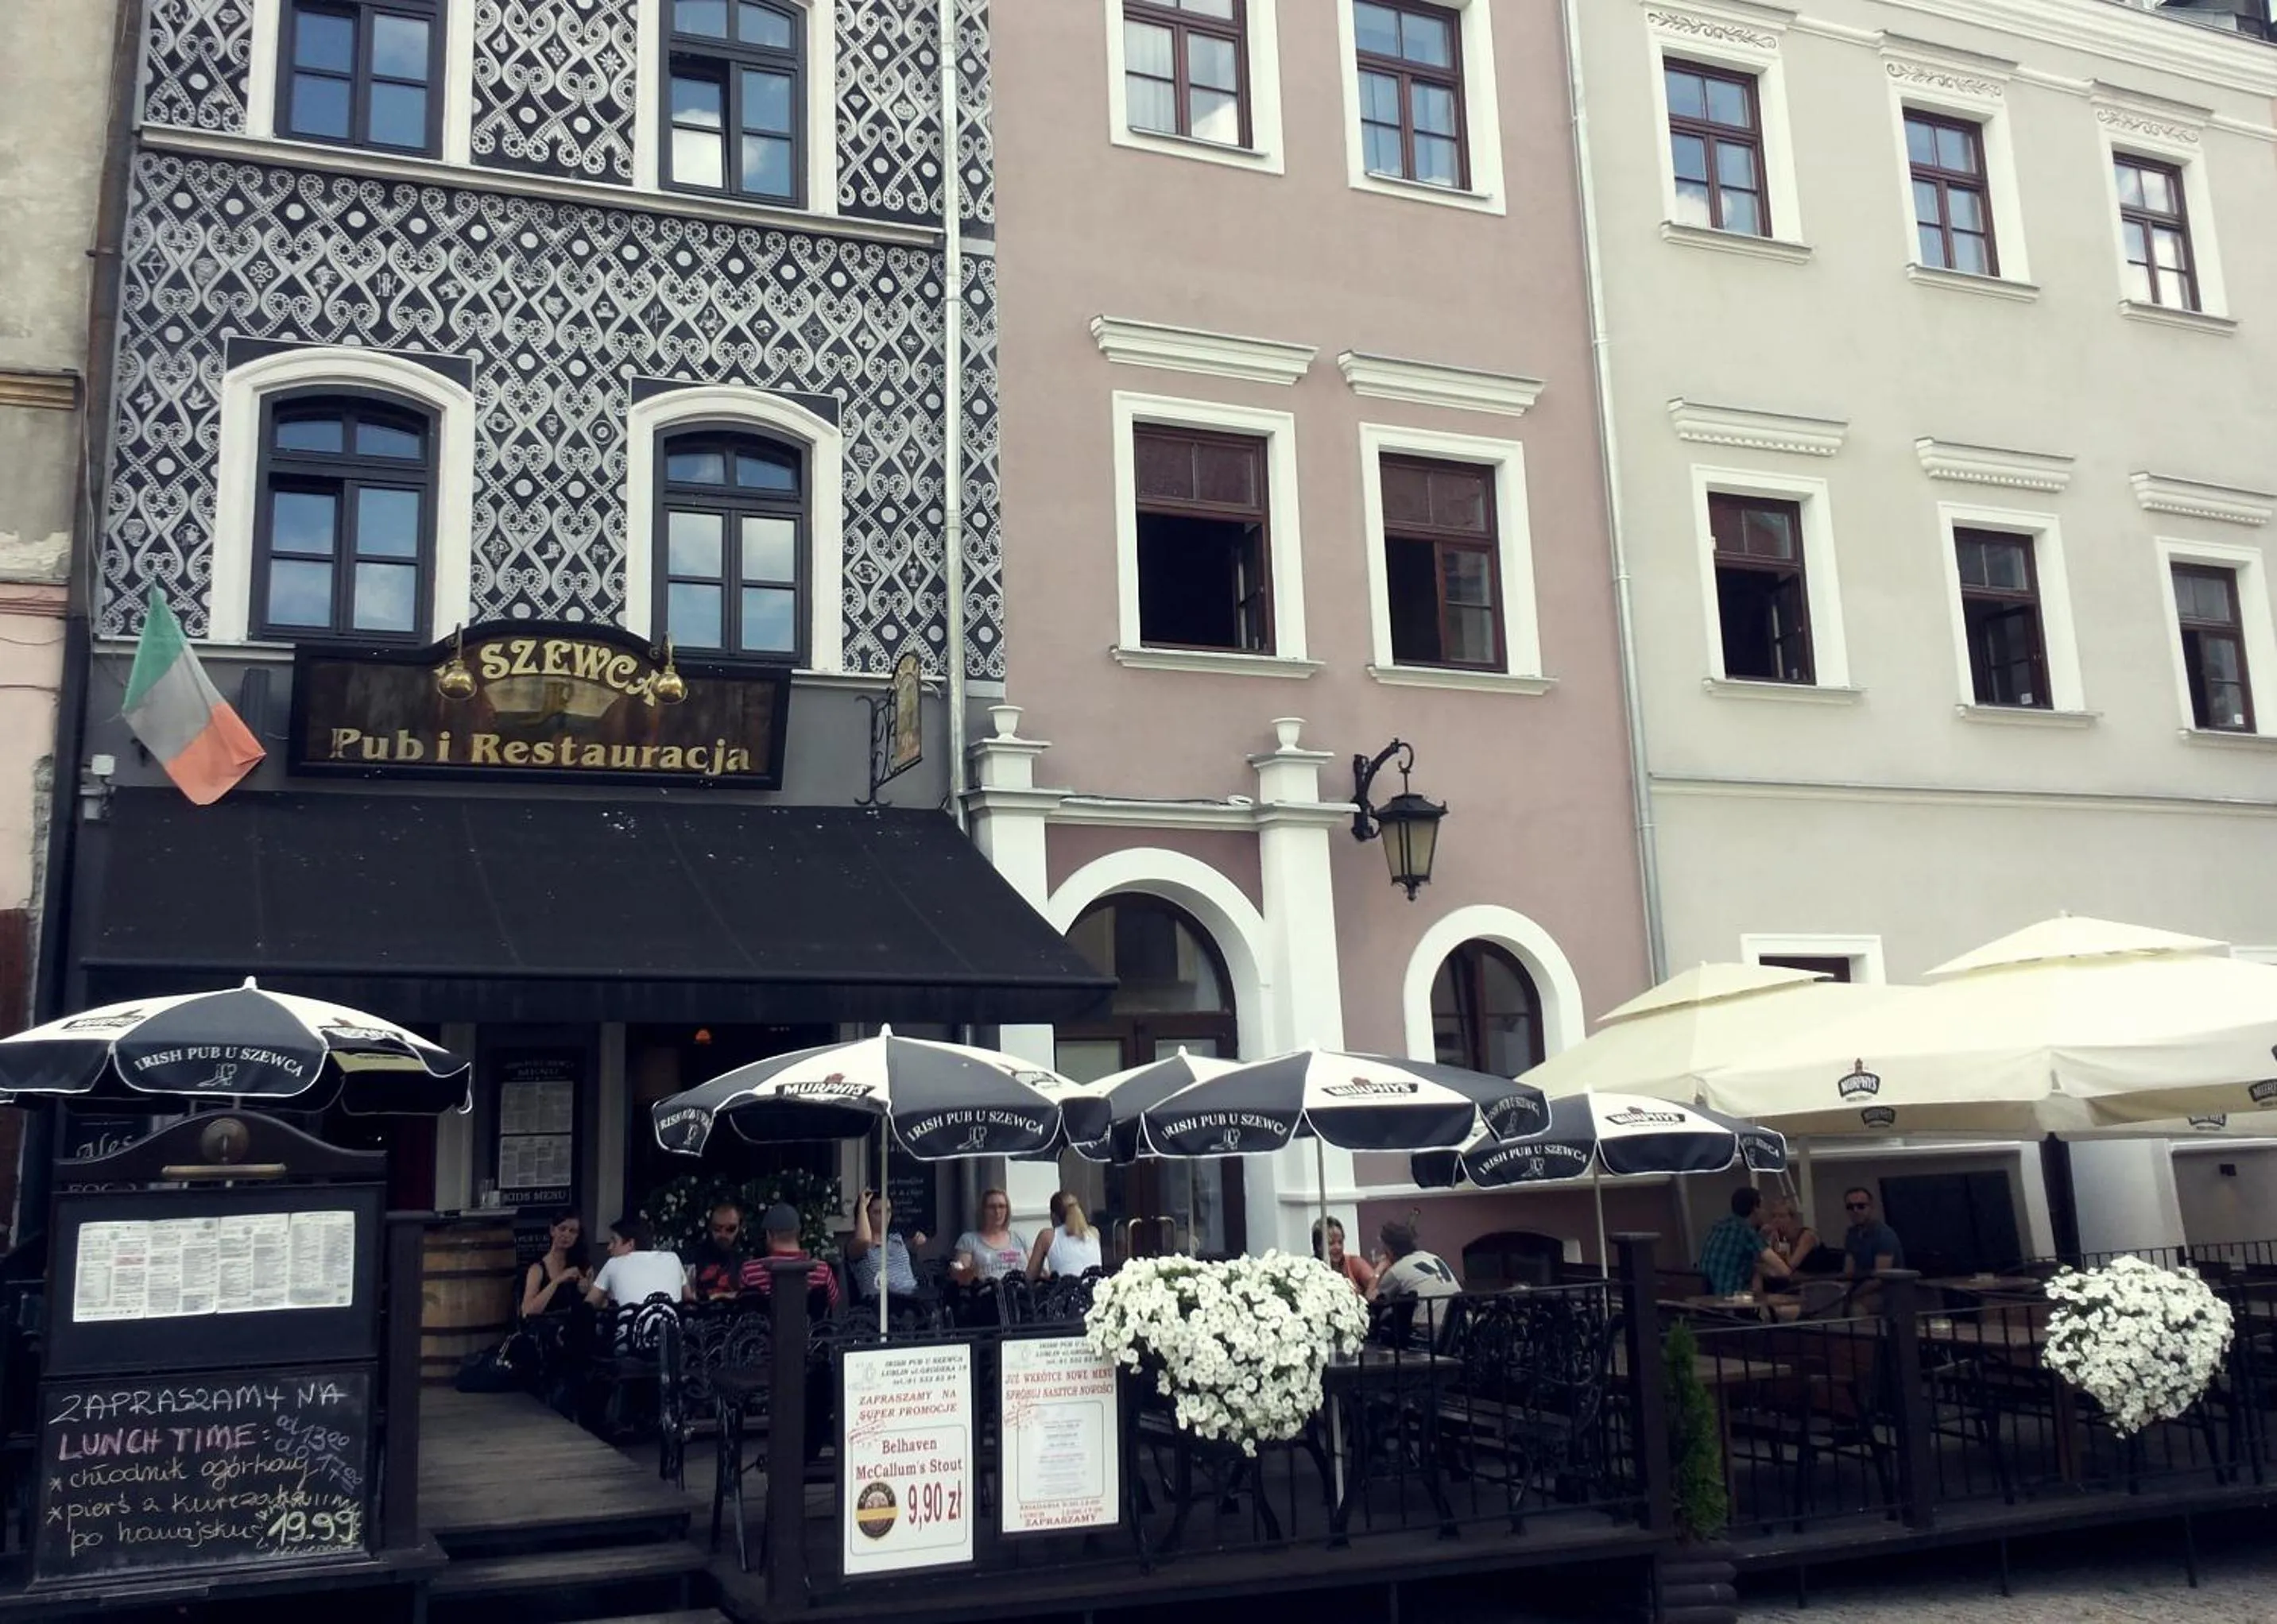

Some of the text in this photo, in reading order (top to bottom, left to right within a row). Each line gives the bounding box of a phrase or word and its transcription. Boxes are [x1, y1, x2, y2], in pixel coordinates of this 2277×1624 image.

[329, 728, 750, 775] Pub i Restauracja
[134, 1046, 304, 1077] IRISH PUB U SZEWCA
[907, 1110, 1044, 1142] IRISH PUB U SZEWCA
[1161, 1112, 1288, 1140] IRISH PUB U SZEWCA
[1478, 1144, 1587, 1175] IRISH PUB U SZEWCA
[48, 1383, 348, 1425] ZAPRASZAMY NA
[858, 1389, 957, 1406] ZAPRASZAMY NA
[858, 1402, 958, 1421] SUPER PROMOCJE
[59, 1427, 162, 1461] LUNCH
[882, 1437, 937, 1454] Belhaven
[930, 1458, 962, 1473] Stout
[908, 1481, 943, 1531] 9,90
[948, 1479, 962, 1520] zł
